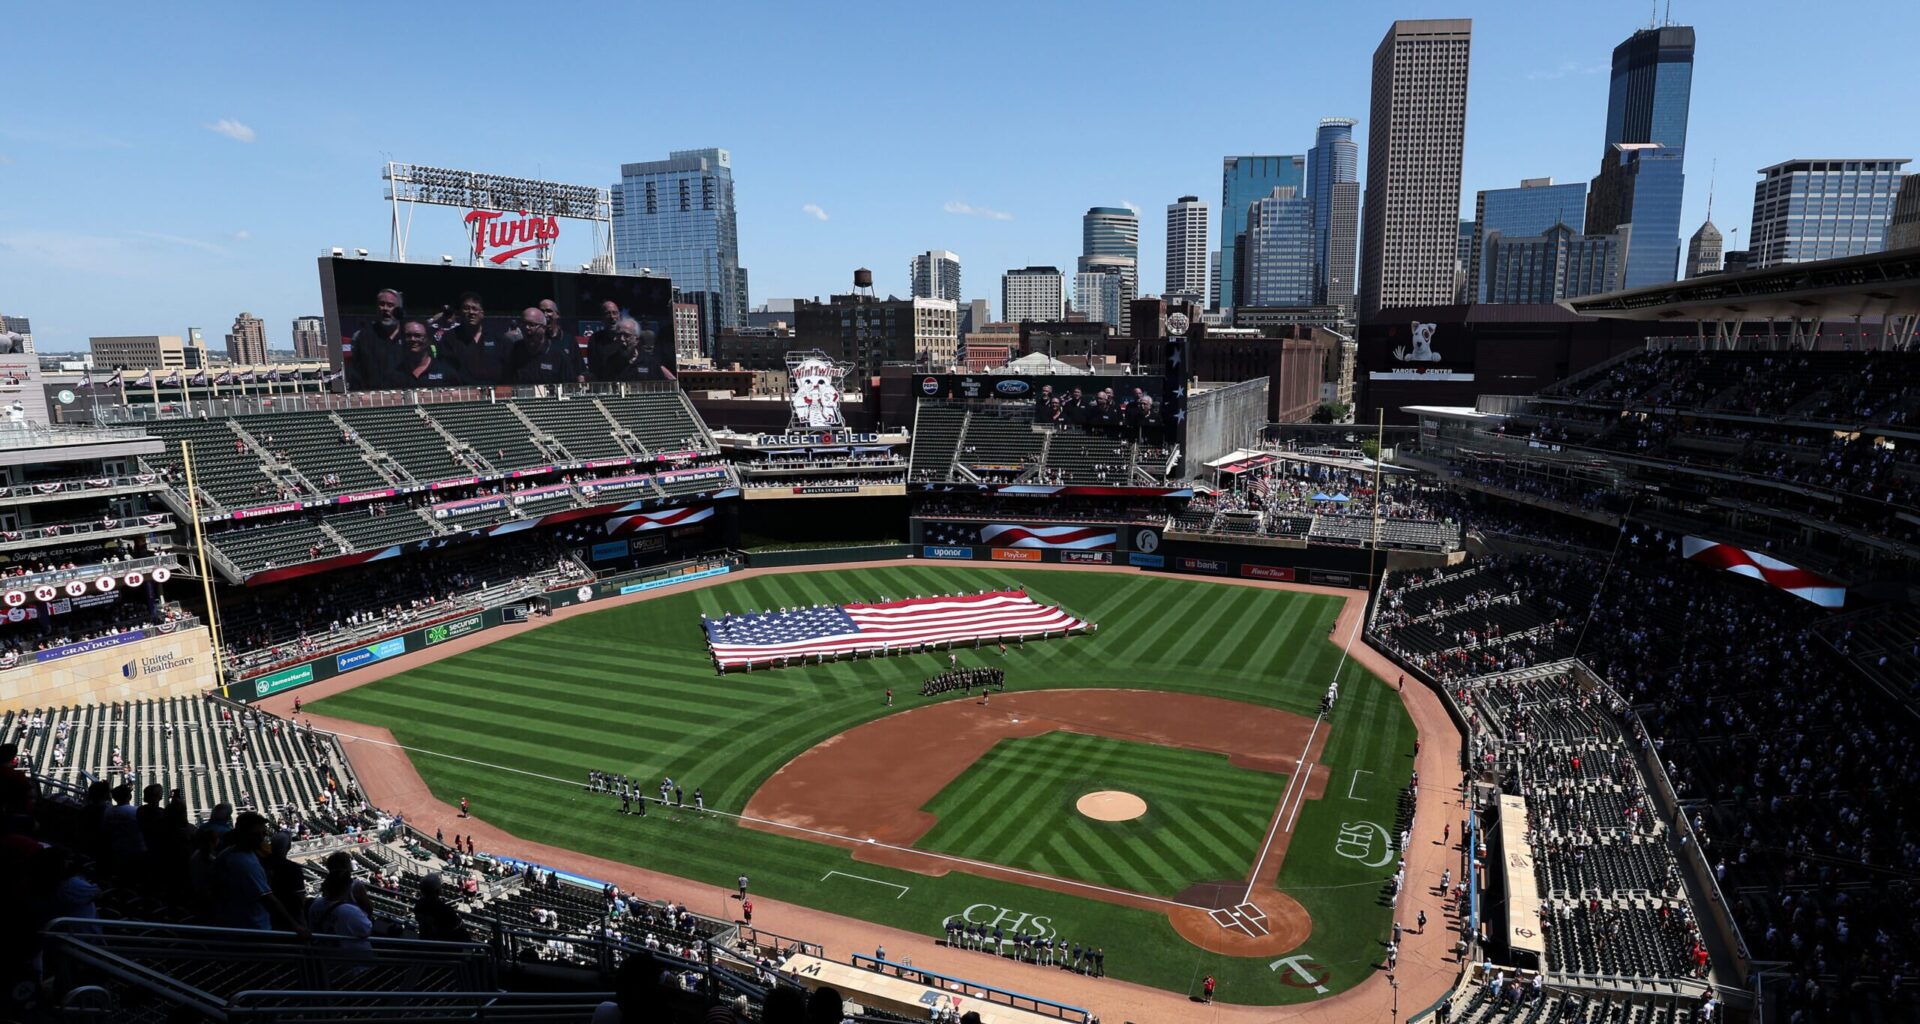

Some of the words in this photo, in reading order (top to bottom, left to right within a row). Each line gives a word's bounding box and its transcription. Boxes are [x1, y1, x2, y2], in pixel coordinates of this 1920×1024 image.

[465, 209, 559, 256] Twins
[1002, 382, 1022, 391] Ford
[759, 434, 820, 445] TARGET
[835, 433, 879, 443] FIELD
[437, 480, 459, 488] Treasure
[459, 478, 475, 486] Island
[597, 483, 625, 491] Treasure
[626, 480, 645, 488] Island
[525, 494, 543, 503] Home
[555, 489, 569, 497] Deck
[242, 506, 273, 518] Treasure
[274, 503, 295, 513] Island
[450, 506, 481, 516] Treasure
[481, 501, 500, 510] Island
[49, 548, 65, 556] ICED
[934, 549, 961, 557] uponor
[1003, 551, 1028, 560] Paycor
[1196, 560, 1218, 570] bank
[159, 571, 165, 579] 3
[39, 589, 53, 598] 34
[71, 585, 82, 593] 14
[449, 617, 479, 631] securian
[61, 643, 91, 656] GRAY
[92, 638, 120, 650] DUCK
[141, 651, 174, 666] United
[346, 652, 371, 664] PENTAIR
[143, 656, 194, 675] Healthcare
[270, 671, 311, 687] JamesHardie
[1335, 822, 1374, 859] CHS
[962, 903, 1052, 937] CHS
